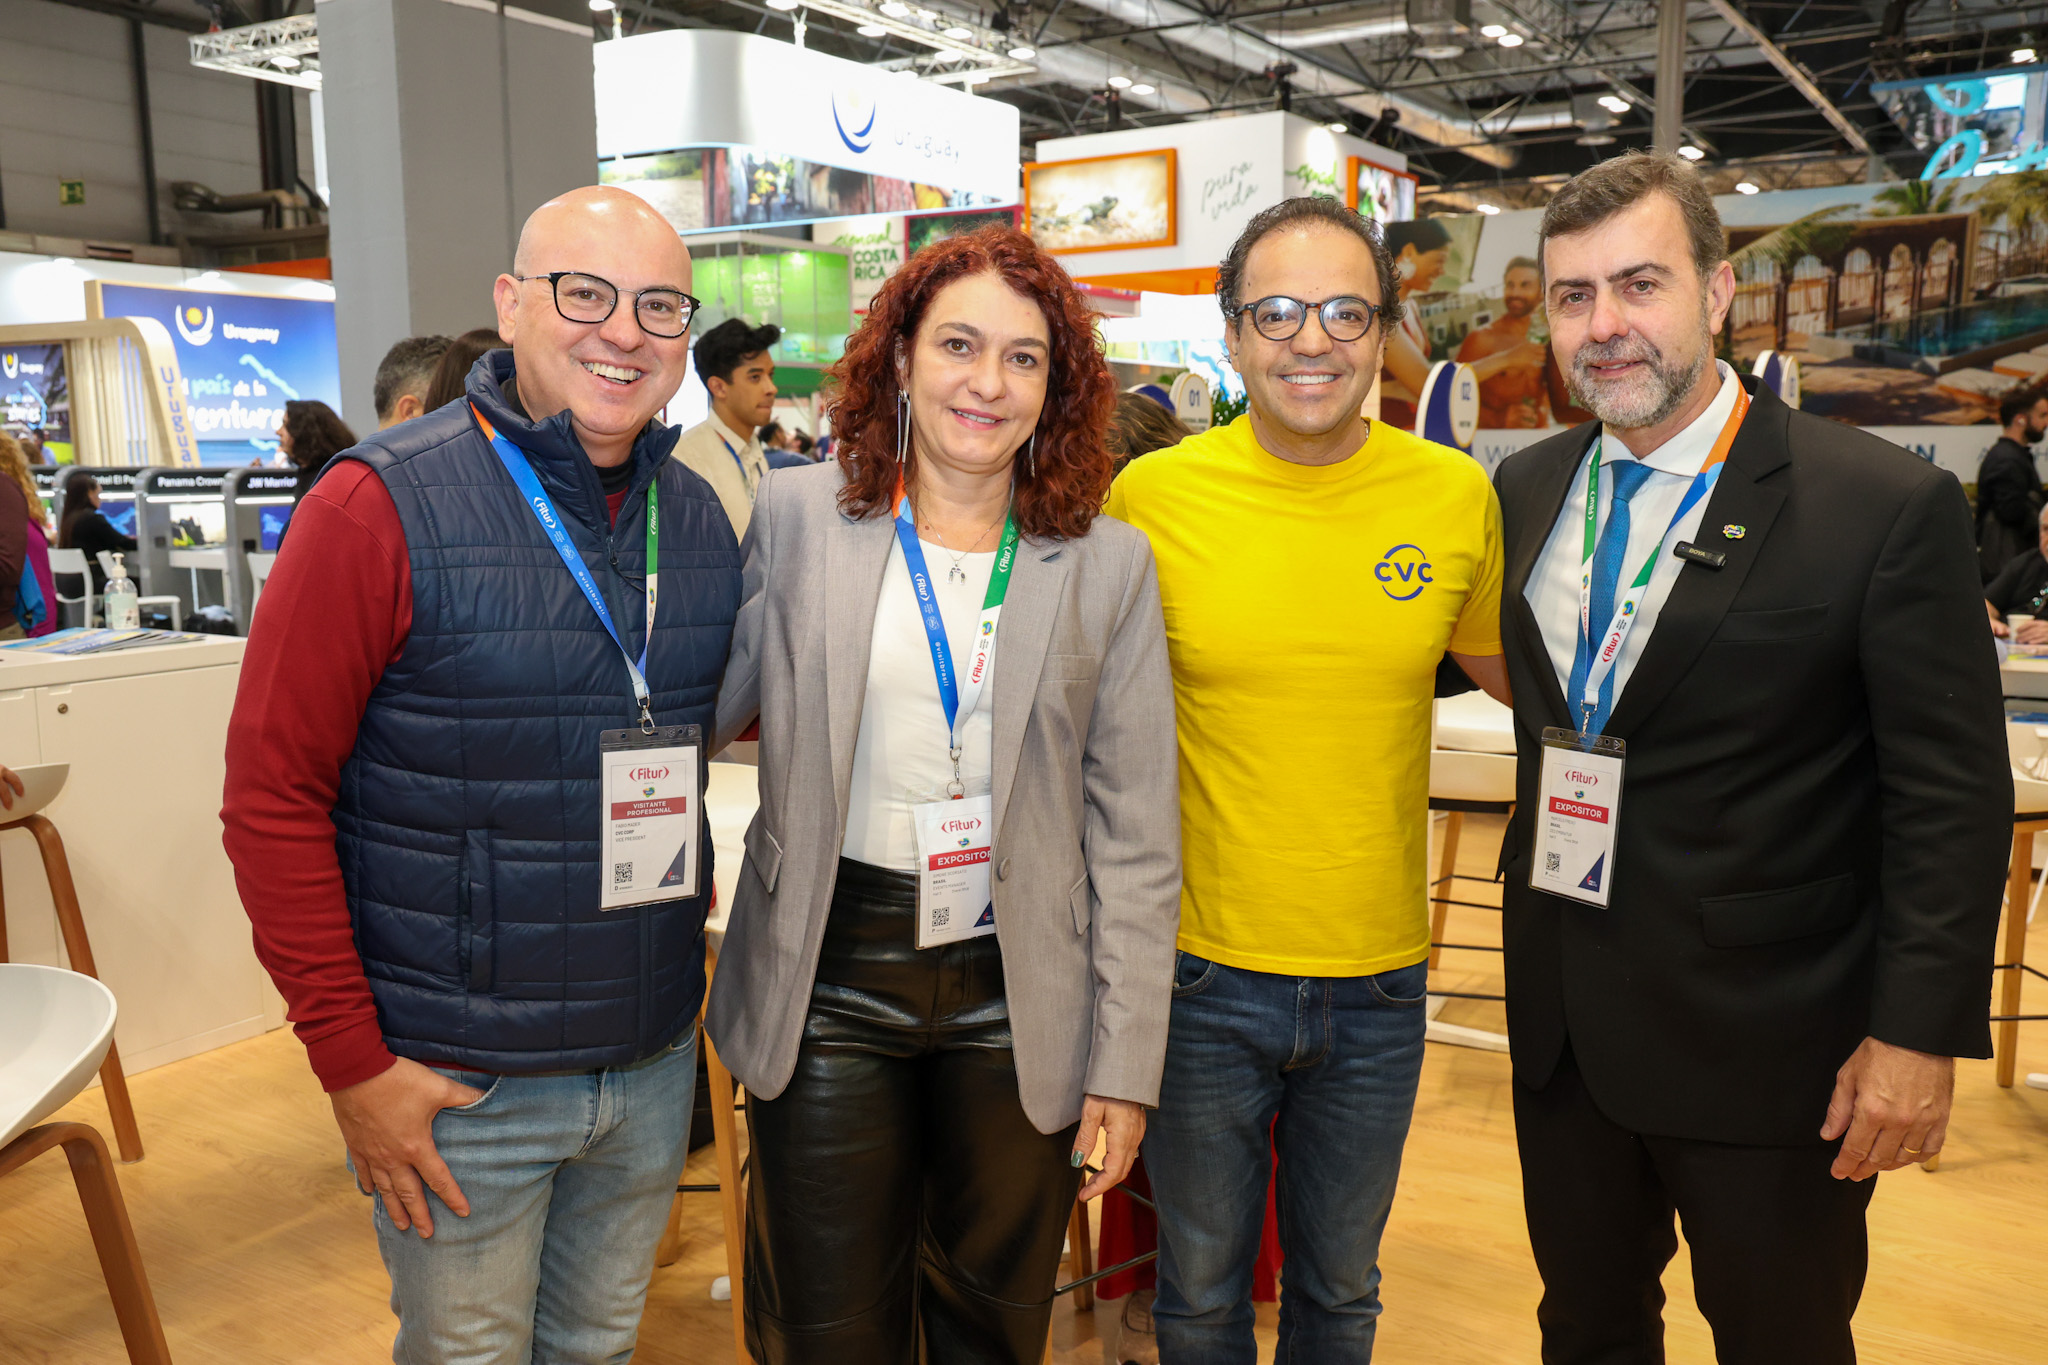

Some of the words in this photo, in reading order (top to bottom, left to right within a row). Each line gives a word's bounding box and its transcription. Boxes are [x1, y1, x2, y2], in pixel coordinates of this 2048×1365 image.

[853, 248, 899, 265] COSTA
[854, 265, 887, 281] RICA
[222, 322, 281, 345] Uruguay
[1188, 389, 1201, 407] 01
[160, 367, 196, 470] Urugua
[157, 476, 196, 488] Panama
[1688, 547, 1707, 558] BOYA
[1373, 561, 1434, 584] CVC
[626, 807, 672, 817] PROFESIONAL
[632, 801, 668, 810] VISITANTE
[1555, 801, 1603, 819] EXPOSITOR
